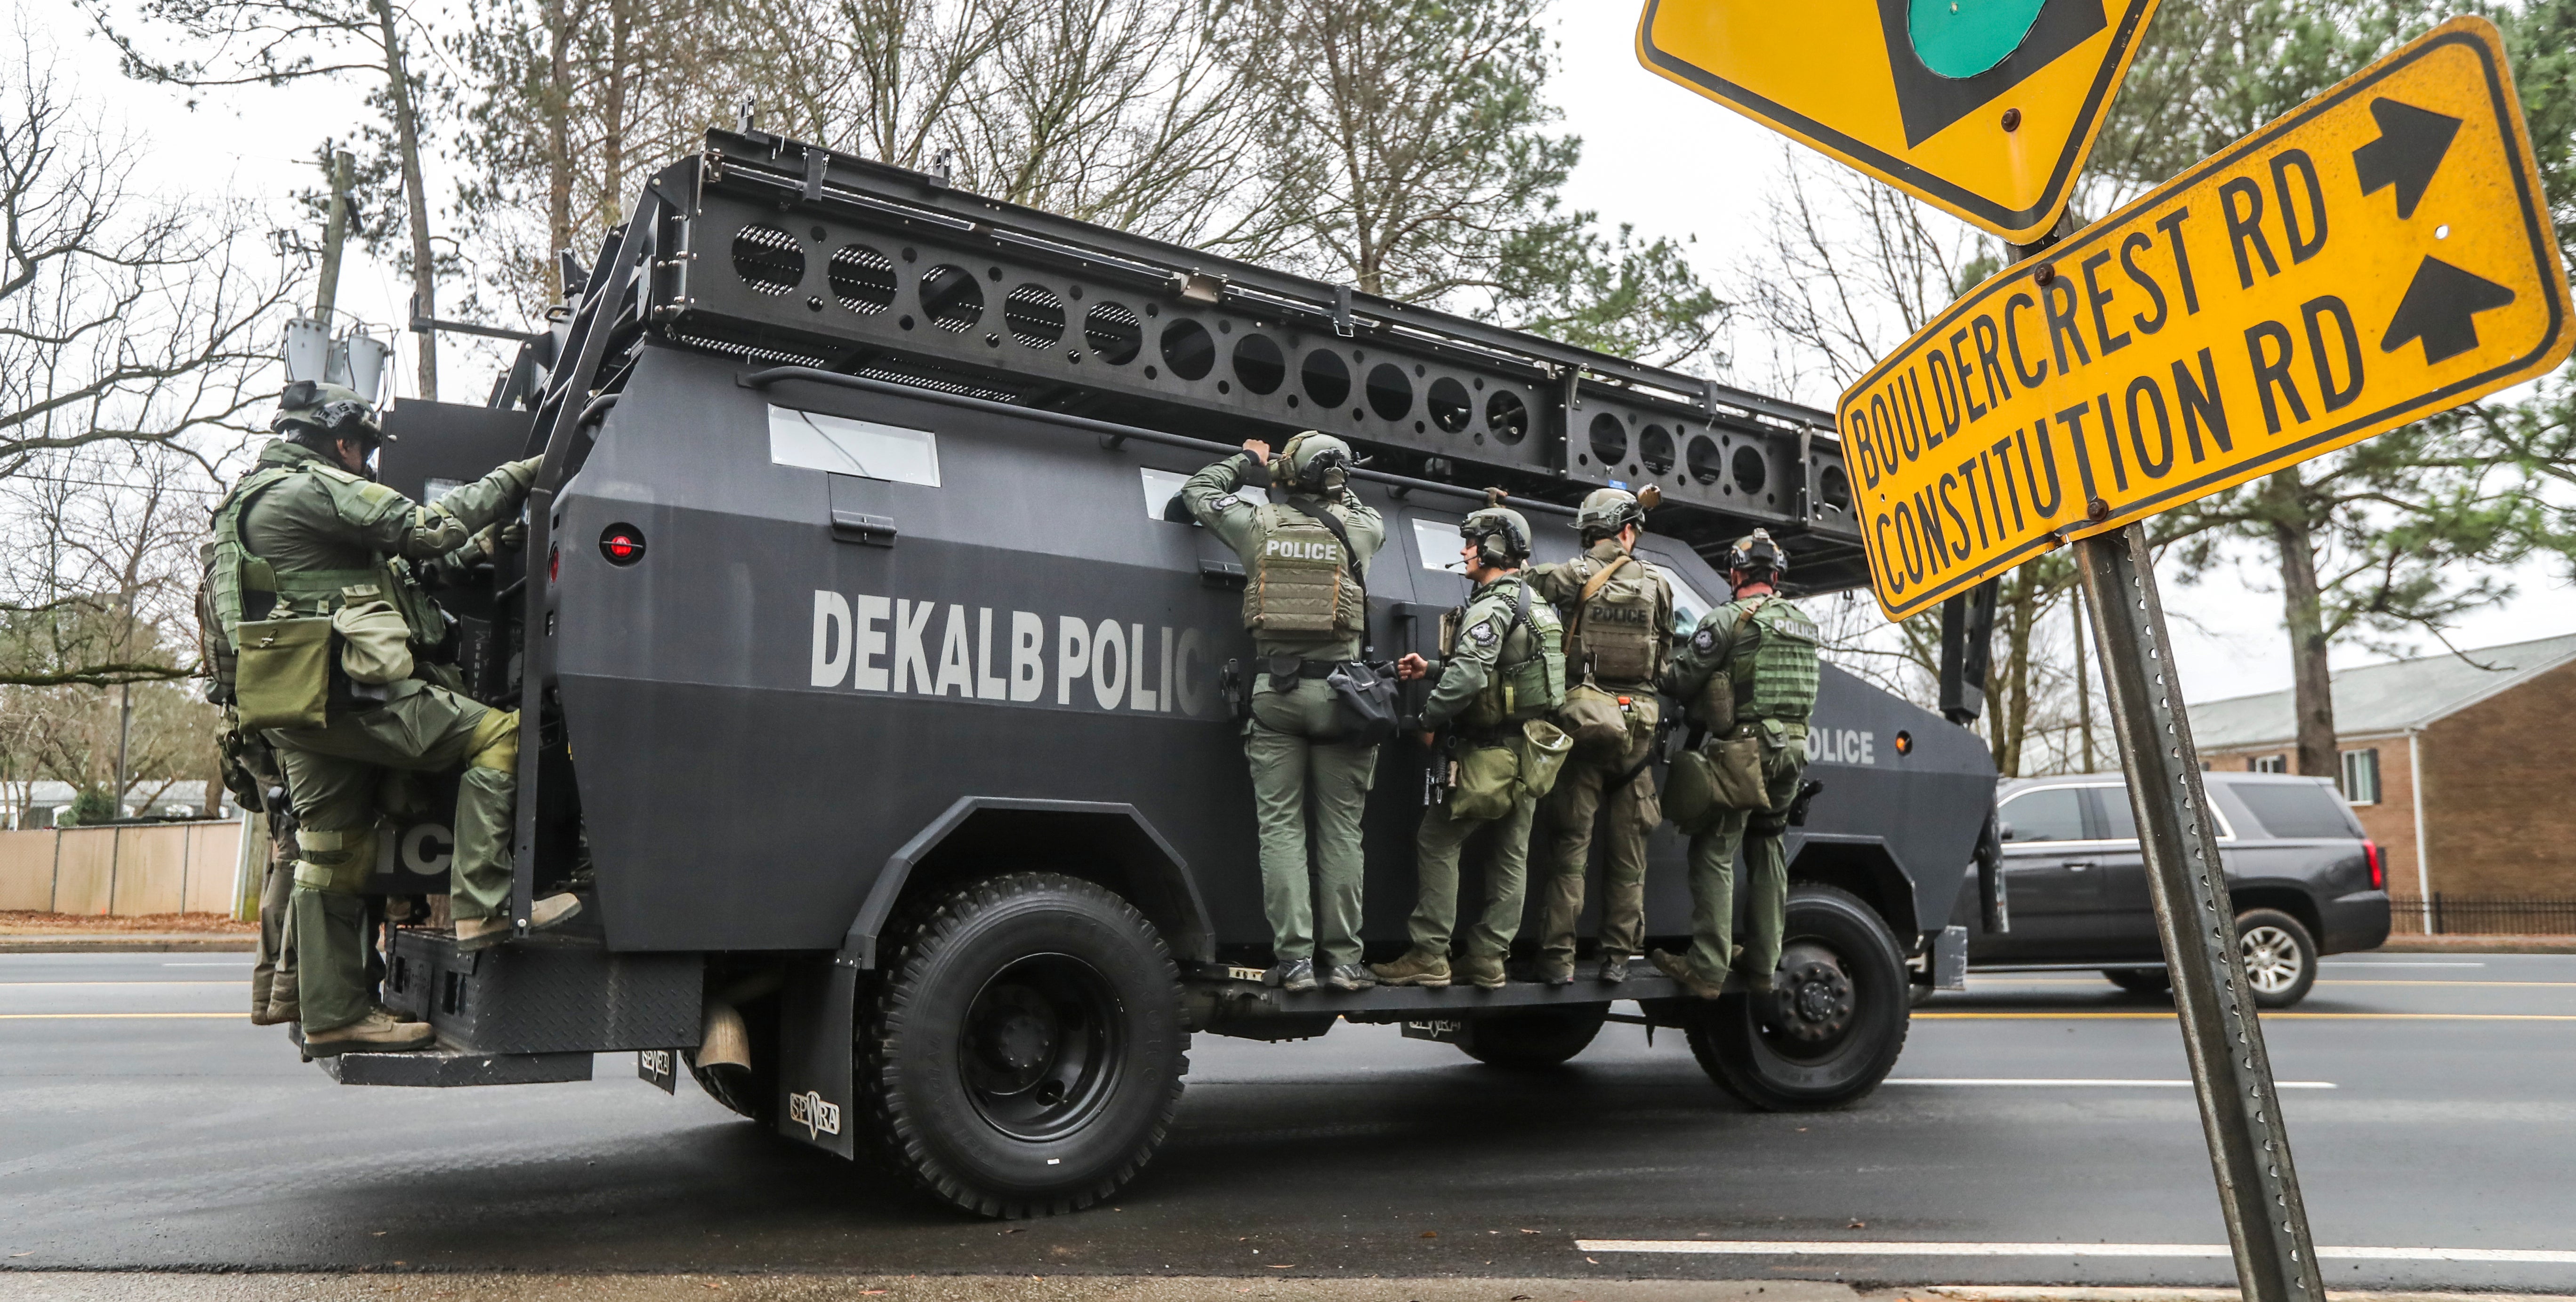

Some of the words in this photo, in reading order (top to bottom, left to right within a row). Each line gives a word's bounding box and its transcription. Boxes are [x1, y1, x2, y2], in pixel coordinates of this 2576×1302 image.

[1851, 206, 2199, 490] BOULDERCREST
[2218, 149, 2328, 289] RD
[1876, 347, 2233, 595] CONSTITUTION
[2244, 295, 2364, 435] RD
[1266, 539, 1337, 561] POLICE
[1592, 606, 1647, 623] POLICE
[1774, 619, 1818, 641] POLICE
[811, 589, 1044, 702] DEKALB
[1057, 615, 1206, 716] POLIC
[1804, 726, 1875, 764] OLICE
